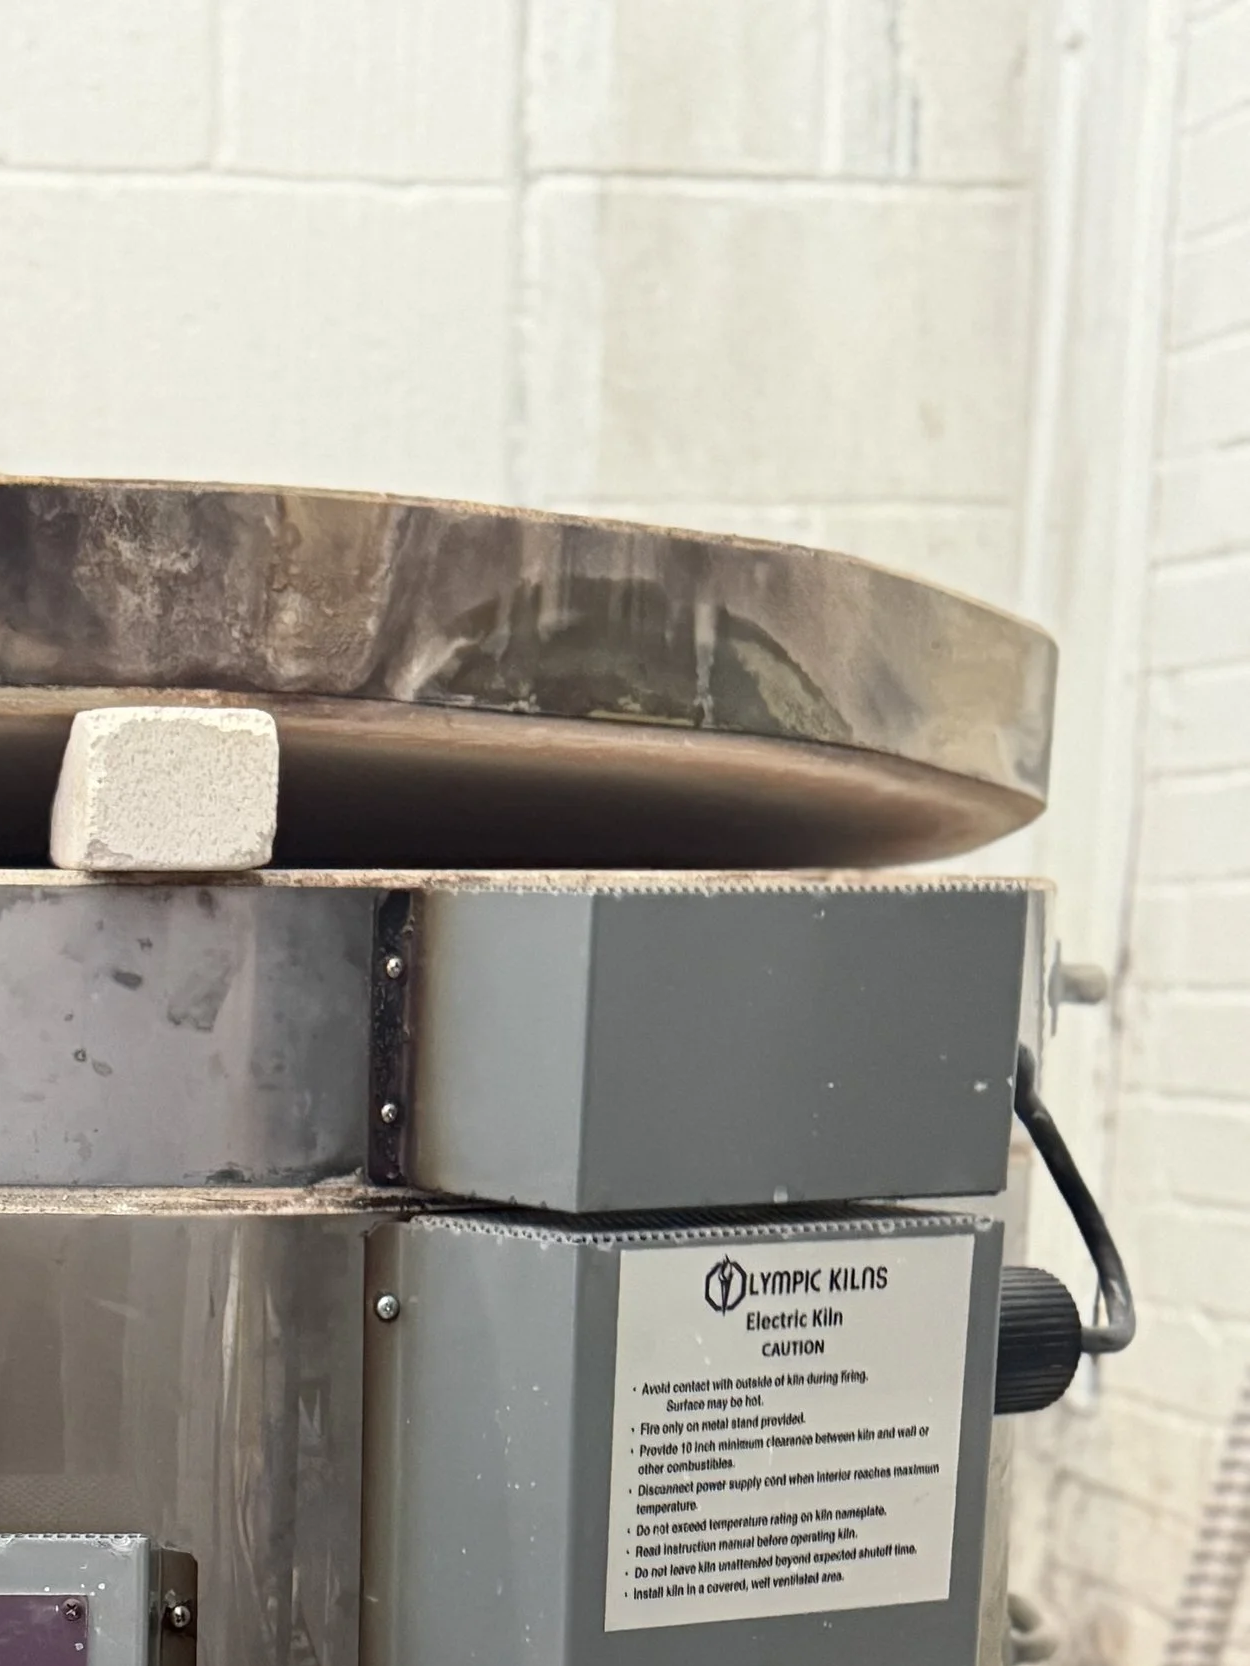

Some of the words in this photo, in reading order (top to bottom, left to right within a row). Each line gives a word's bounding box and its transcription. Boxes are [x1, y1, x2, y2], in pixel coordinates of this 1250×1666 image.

[829, 1265, 888, 1291] KILNS
[747, 1309, 807, 1331] Electric
[812, 1307, 843, 1327] Kiln
[762, 1340, 825, 1357] CAUTION
[642, 1382, 670, 1395] Avoid
[673, 1379, 709, 1393] contact
[713, 1378, 733, 1391] with
[736, 1376, 771, 1389] outside
[775, 1375, 785, 1387] of
[787, 1373, 804, 1386] kiln
[807, 1371, 838, 1386] during
[841, 1369, 868, 1383] firing.
[666, 1399, 704, 1412] Surface
[707, 1399, 727, 1411] may
[731, 1397, 742, 1408] be
[745, 1394, 764, 1407] hot.
[640, 1422, 660, 1436] Fire
[662, 1421, 684, 1435] only
[687, 1421, 699, 1432] on
[702, 1417, 728, 1431] metal
[731, 1416, 758, 1429] stand
[761, 1412, 805, 1430] provided.
[640, 1444, 678, 1457] Provide
[682, 1442, 692, 1454] 10
[694, 1440, 715, 1453] inch
[718, 1438, 763, 1451] minimum
[767, 1434, 813, 1448] clearance
[815, 1431, 855, 1445] between
[858, 1428, 875, 1441] kiln
[877, 1427, 895, 1439] and
[897, 1425, 917, 1438] wall
[919, 1426, 929, 1436] or
[638, 1463, 664, 1475] other
[667, 1458, 735, 1474] combustibles.
[638, 1482, 694, 1497] Disconnect
[696, 1480, 726, 1494] power
[729, 1477, 762, 1491] supply
[764, 1474, 786, 1487] cord
[789, 1472, 814, 1486] when
[817, 1469, 851, 1482] interior
[854, 1466, 891, 1480] reaches
[893, 1464, 939, 1477] maximum
[636, 1500, 698, 1517] temperature.
[636, 1524, 650, 1537] Do
[653, 1523, 669, 1536] not
[672, 1519, 707, 1534] exceed
[709, 1516, 768, 1531] temperature
[770, 1510, 798, 1526] rating
[801, 1512, 813, 1523] on
[815, 1509, 833, 1522] kiln
[636, 1545, 661, 1558] Read
[663, 1540, 716, 1556] instruction
[719, 1536, 754, 1551] manual
[757, 1535, 788, 1547] before
[791, 1529, 835, 1546] operating
[838, 1528, 858, 1540] kiln.
[635, 1566, 649, 1579] Do
[651, 1565, 667, 1578] not
[670, 1563, 696, 1576] leave
[699, 1560, 716, 1573] kiln
[718, 1556, 773, 1571] unattended
[775, 1552, 811, 1569] beyond
[814, 1548, 856, 1565] expected
[858, 1544, 892, 1559] shutoff
[895, 1543, 917, 1557] time.
[633, 1587, 663, 1600] Install
[666, 1584, 684, 1597] kiln
[687, 1583, 696, 1595] in
[699, 1584, 704, 1594] a
[707, 1578, 748, 1594] covered,
[751, 1577, 770, 1590] well
[773, 1571, 819, 1588] ventilated
[822, 1572, 844, 1583] area.
